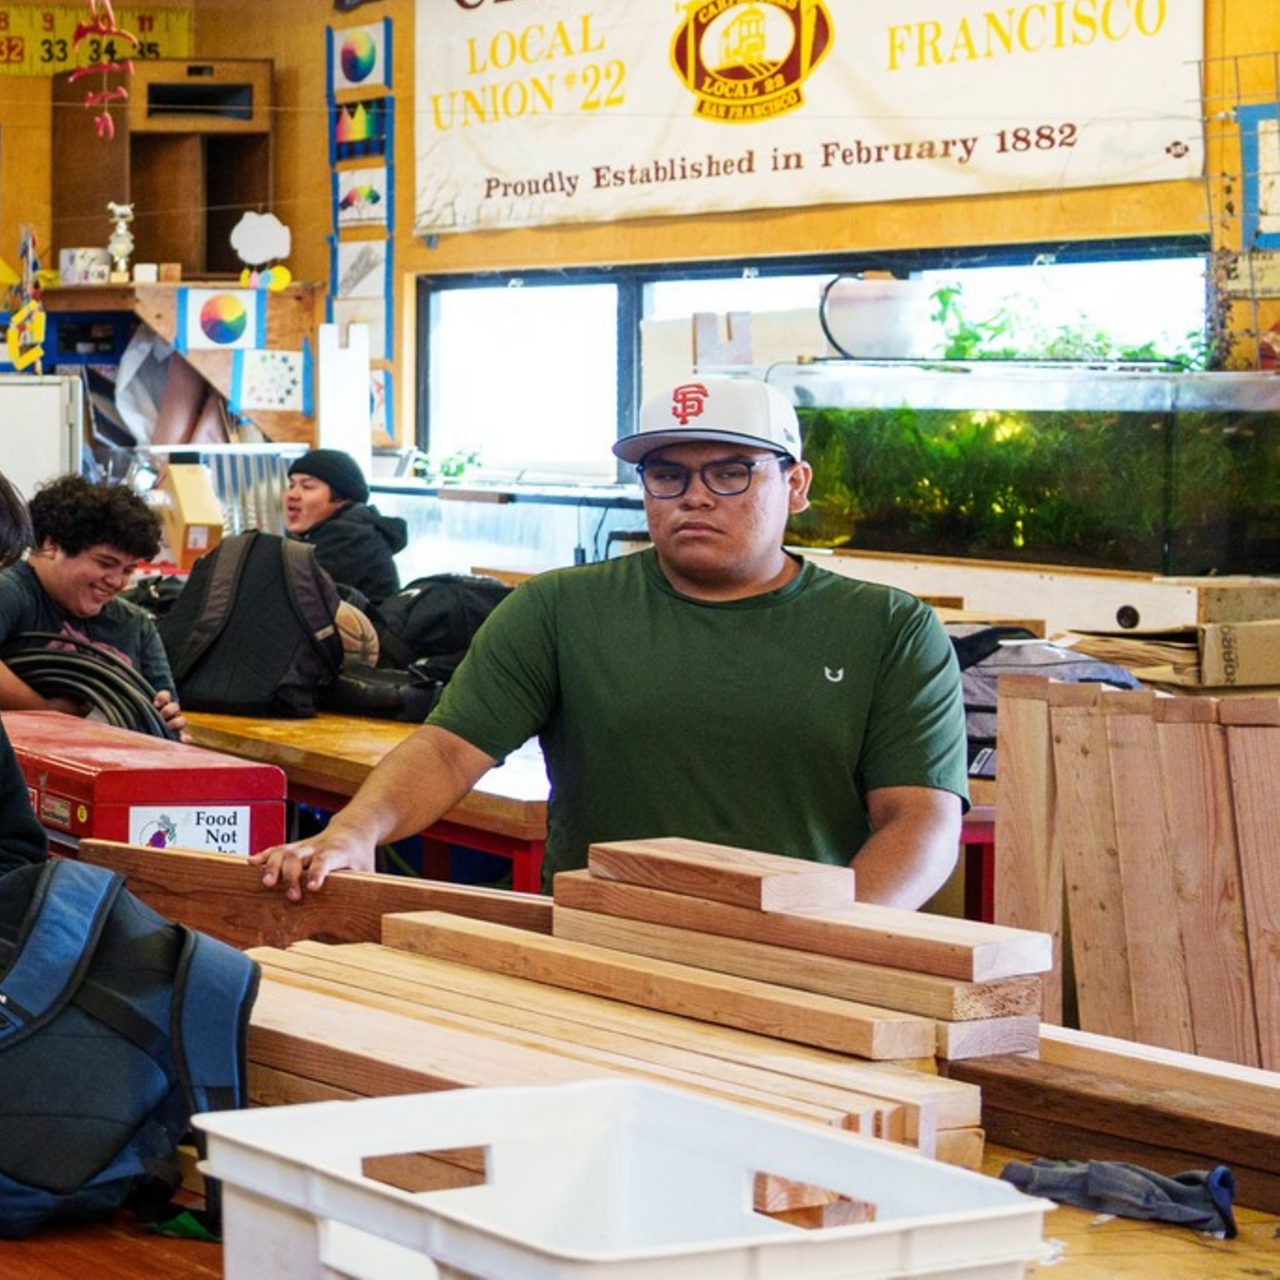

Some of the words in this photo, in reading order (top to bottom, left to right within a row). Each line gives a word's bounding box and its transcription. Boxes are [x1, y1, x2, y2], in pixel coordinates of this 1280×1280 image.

[42, 12, 54, 31] 9
[138, 14, 154, 32] 11
[40, 39, 68, 62] 33
[88, 38, 118, 61] 34
[467, 13, 605, 75] LOCAL
[702, 76, 759, 99] LOCAL
[764, 74, 786, 93] 22
[432, 77, 554, 132] UNION
[701, 100, 727, 119] SAN
[729, 89, 799, 120] FRANCISCO
[484, 167, 580, 200] Proudly
[592, 149, 756, 194] Established
[771, 145, 804, 172] in
[820, 133, 979, 171] February
[995, 122, 1078, 154] 1882
[195, 811, 238, 827] Food
[205, 828, 238, 844] Not
